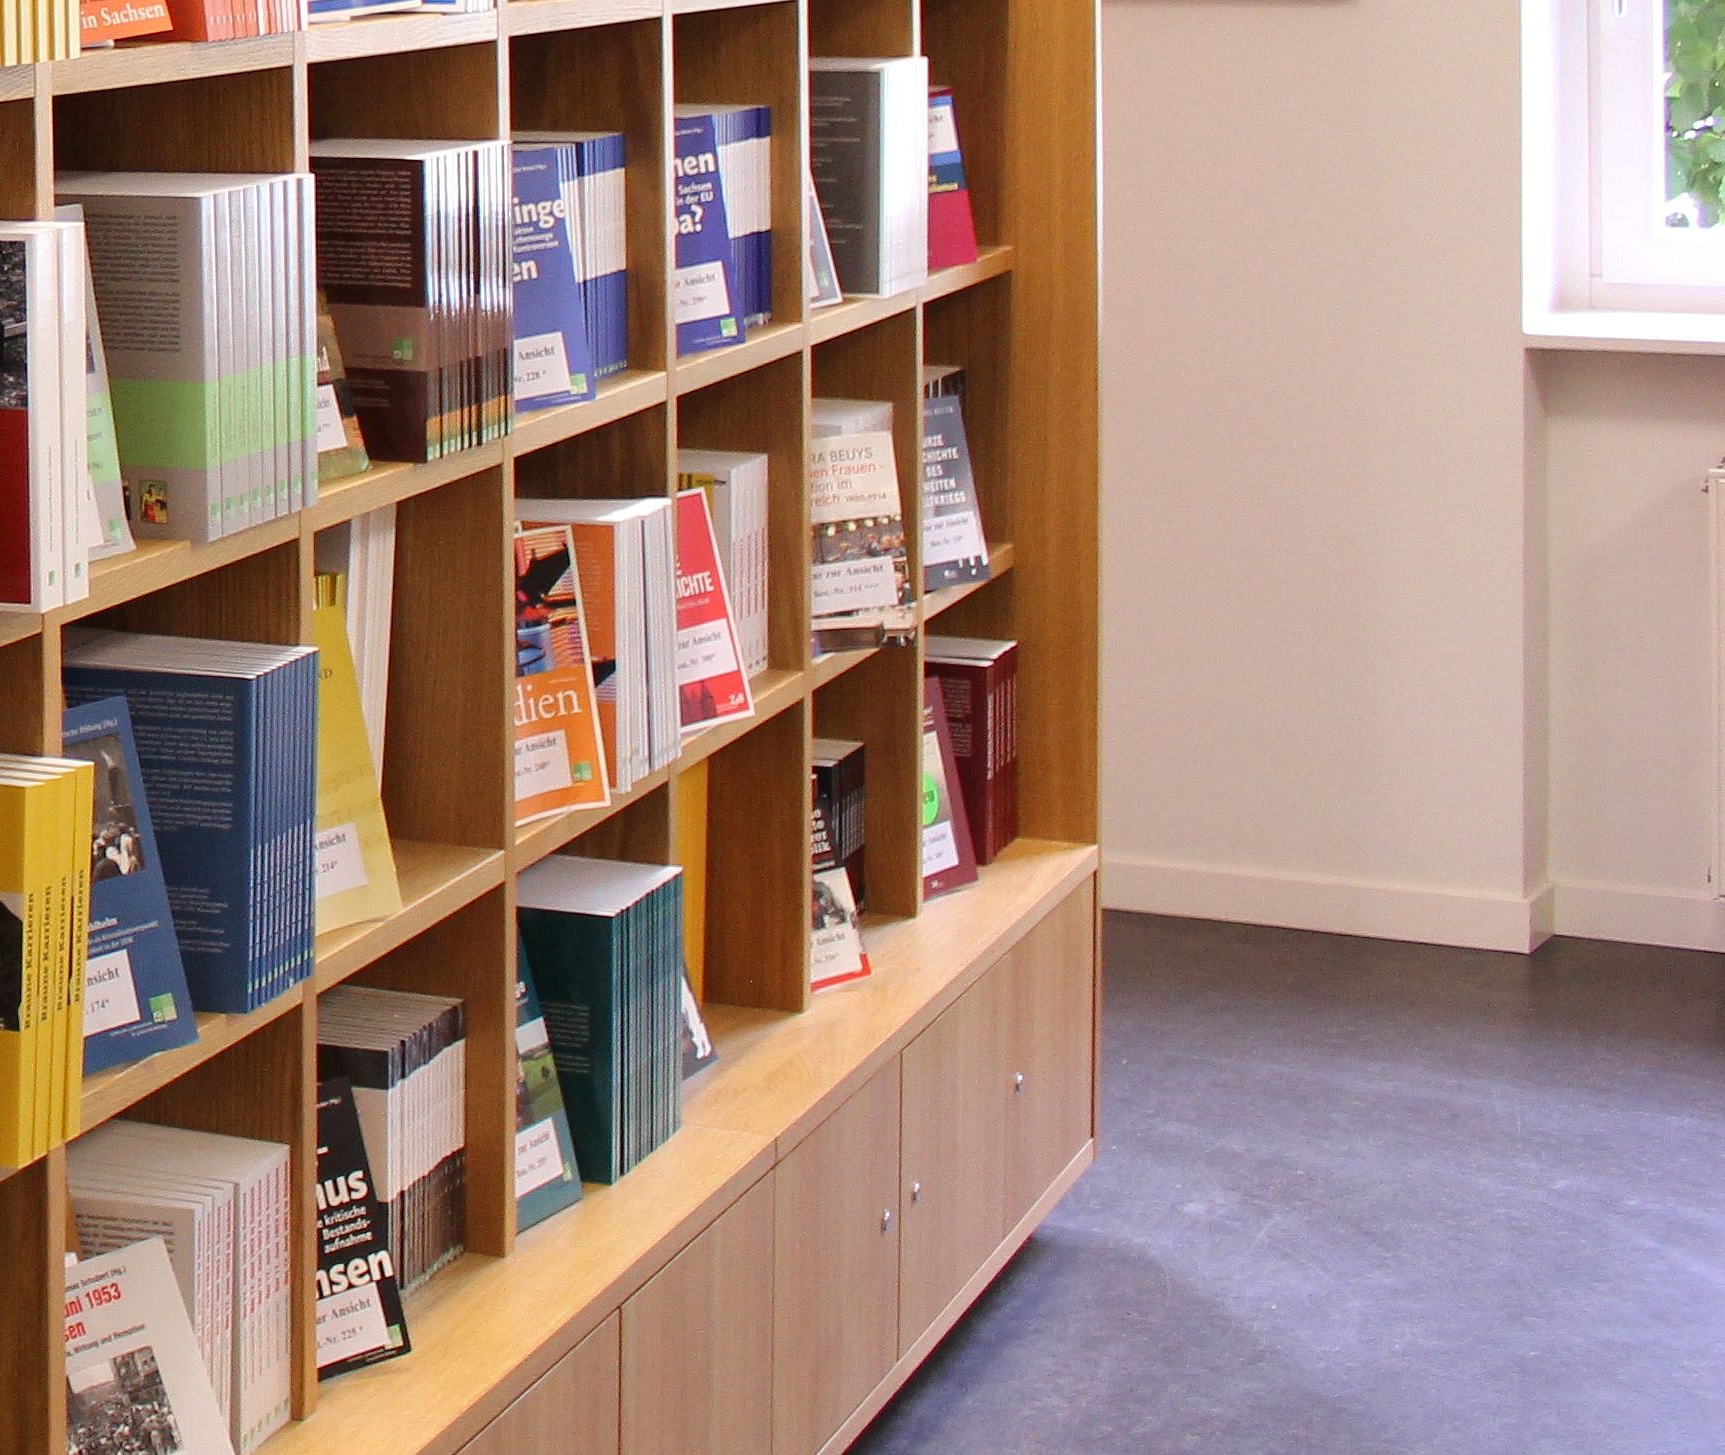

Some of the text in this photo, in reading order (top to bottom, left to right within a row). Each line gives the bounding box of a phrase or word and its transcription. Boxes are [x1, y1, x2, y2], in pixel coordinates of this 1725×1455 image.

[83, 3, 165, 28] in Sachsen
[830, 447, 873, 463] BEUYS
[832, 464, 876, 477] Frauen
[24, 893, 33, 1029] Braune Karrieren
[41, 885, 51, 1021] Braune Karrieren
[324, 1205, 366, 1227] kritische
[87, 1283, 122, 1308] 1953
[331, 1298, 371, 1320] Ansicht
